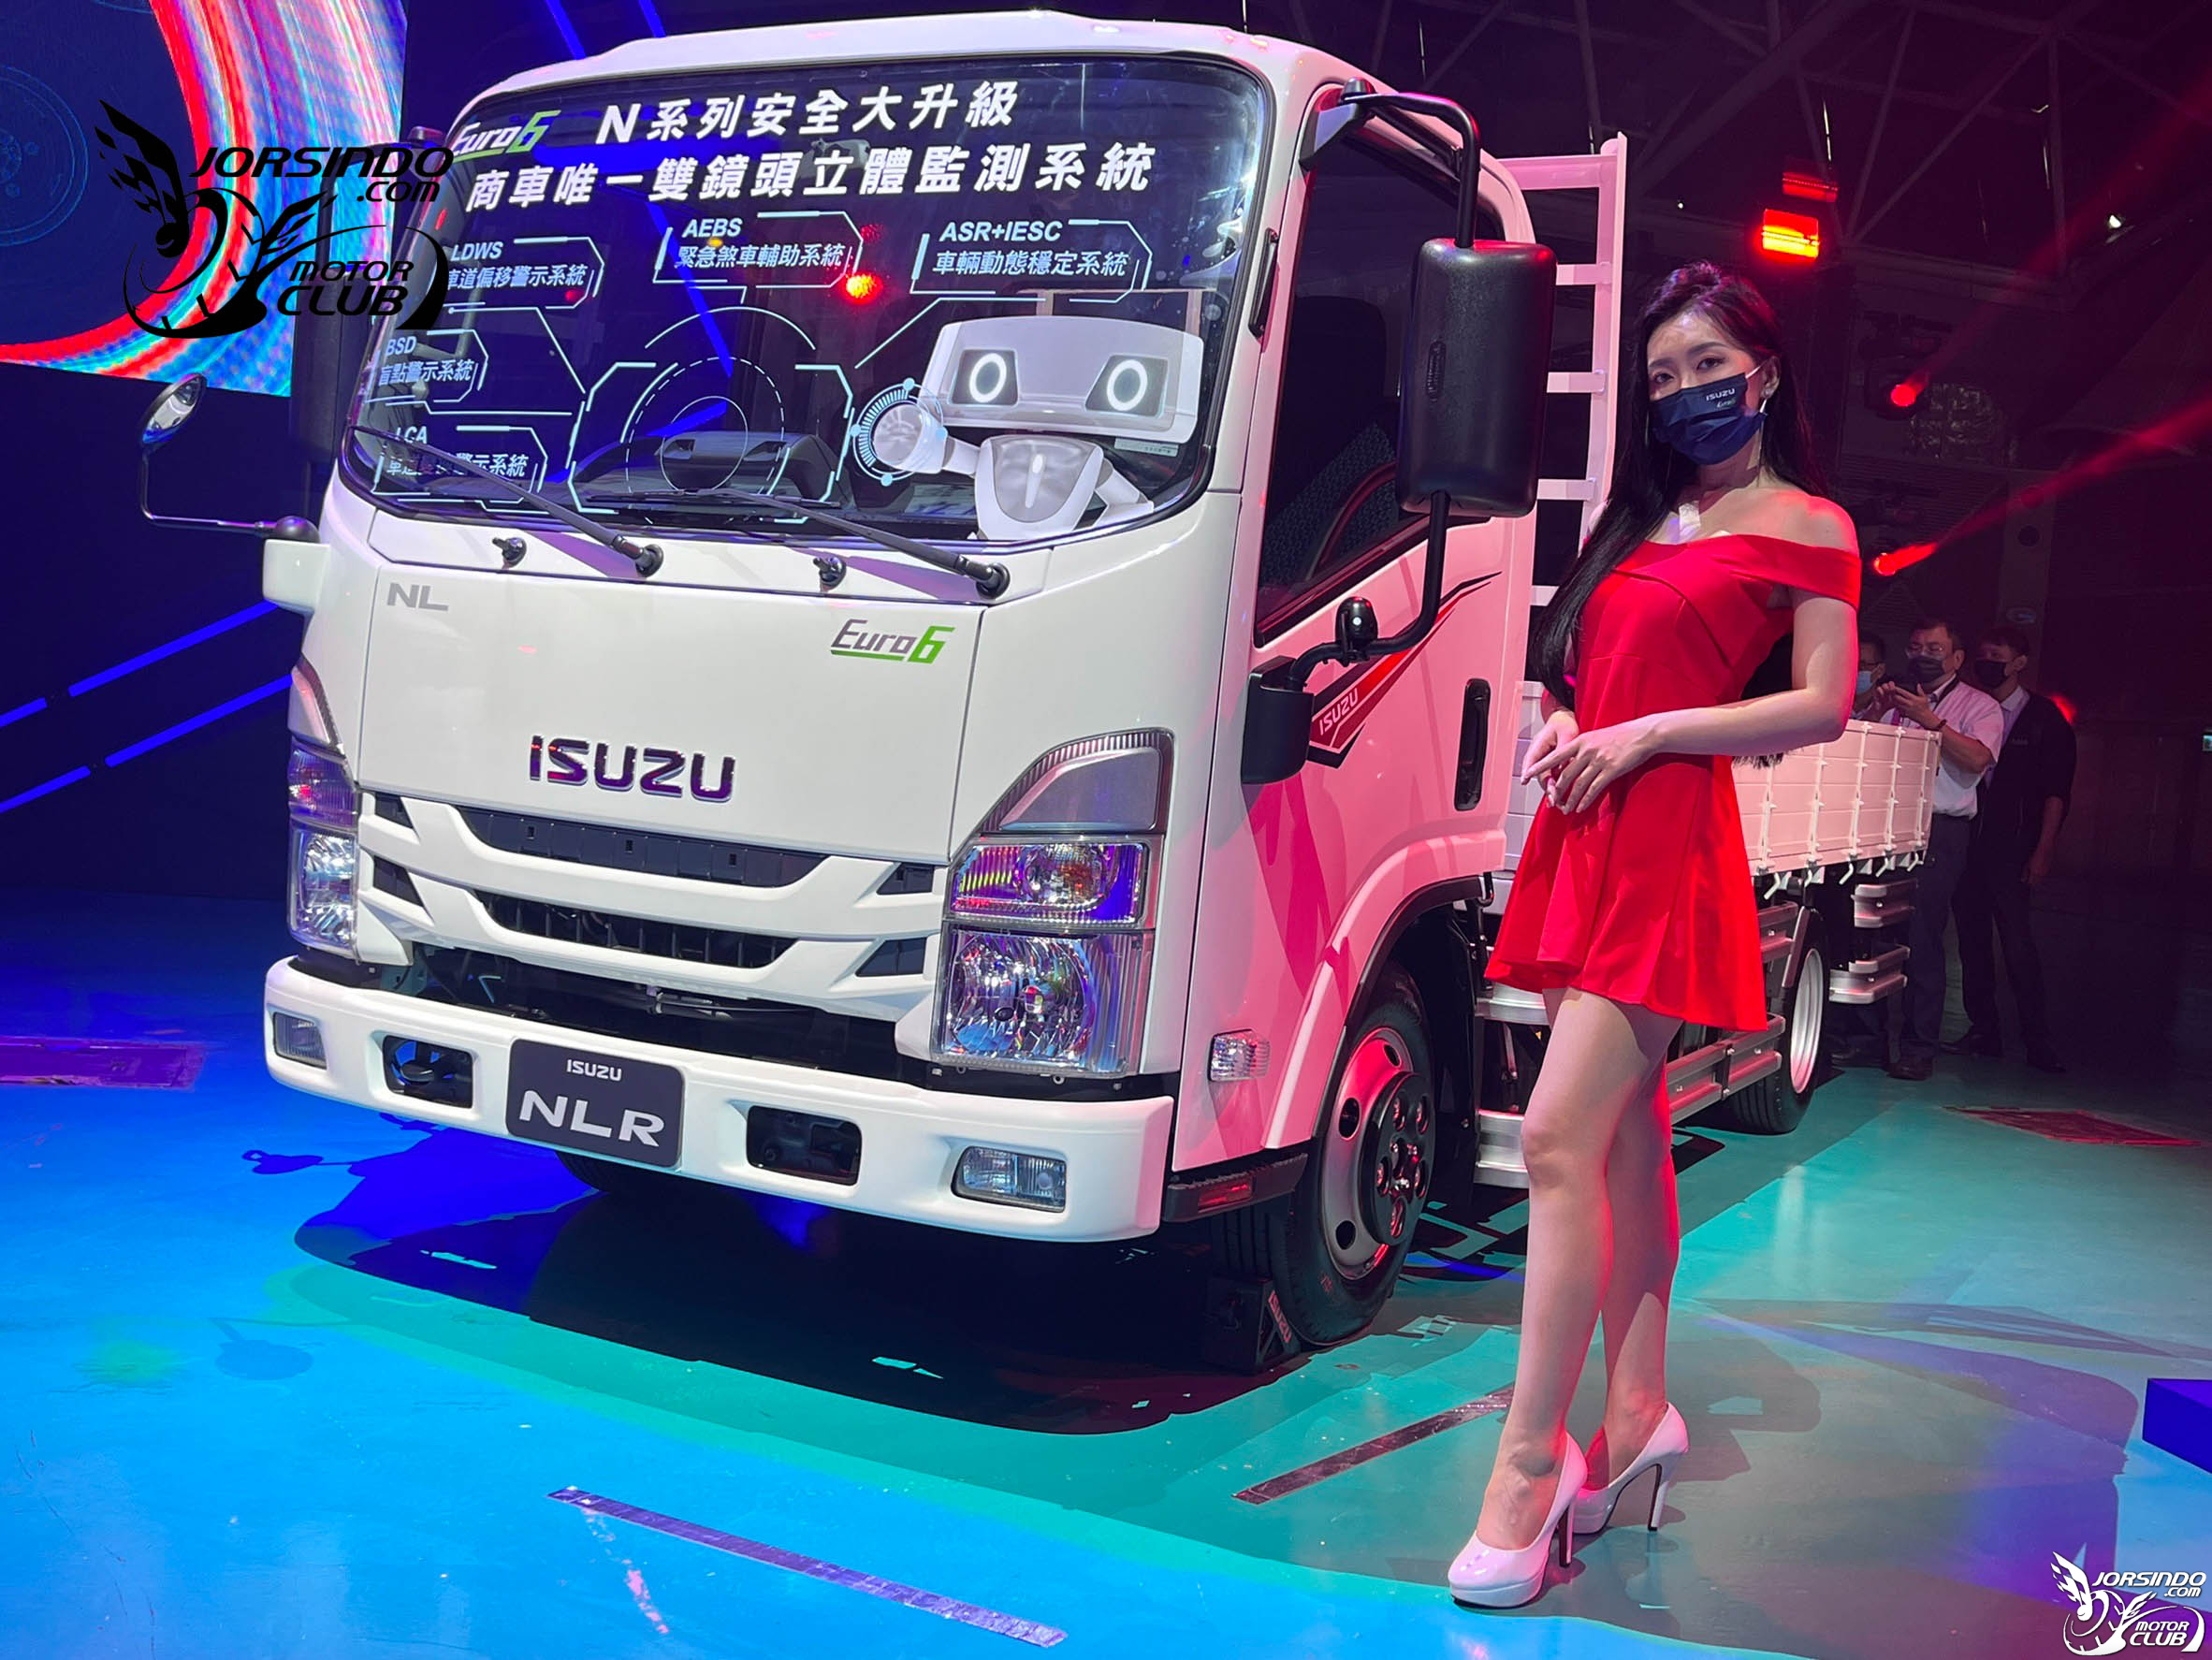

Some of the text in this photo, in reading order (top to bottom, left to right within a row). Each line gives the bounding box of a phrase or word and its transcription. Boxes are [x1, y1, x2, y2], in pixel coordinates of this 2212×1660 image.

[595, 80, 1018, 144] N系列安全大升級
[451, 109, 561, 156] Euro6
[465, 141, 1156, 212] 商車唯一雙鏡頭立體監測系統
[681, 217, 744, 239] AEBS
[939, 219, 1063, 242] ASR+IESC
[450, 240, 504, 262] LDWS
[674, 243, 846, 269] 緊急煞車輔助系統
[933, 250, 1130, 276] 車輛動態穩定系統
[386, 336, 417, 357] BSD
[378, 358, 475, 387] 盲點警示系統
[1706, 387, 1736, 401] ISUZU
[386, 581, 449, 612] NL
[830, 618, 956, 665] Euro6
[1318, 687, 1359, 736] ISUZU
[529, 734, 736, 804] ISUZU
[565, 1058, 622, 1082] ISUZU
[518, 1089, 665, 1147] NLR
